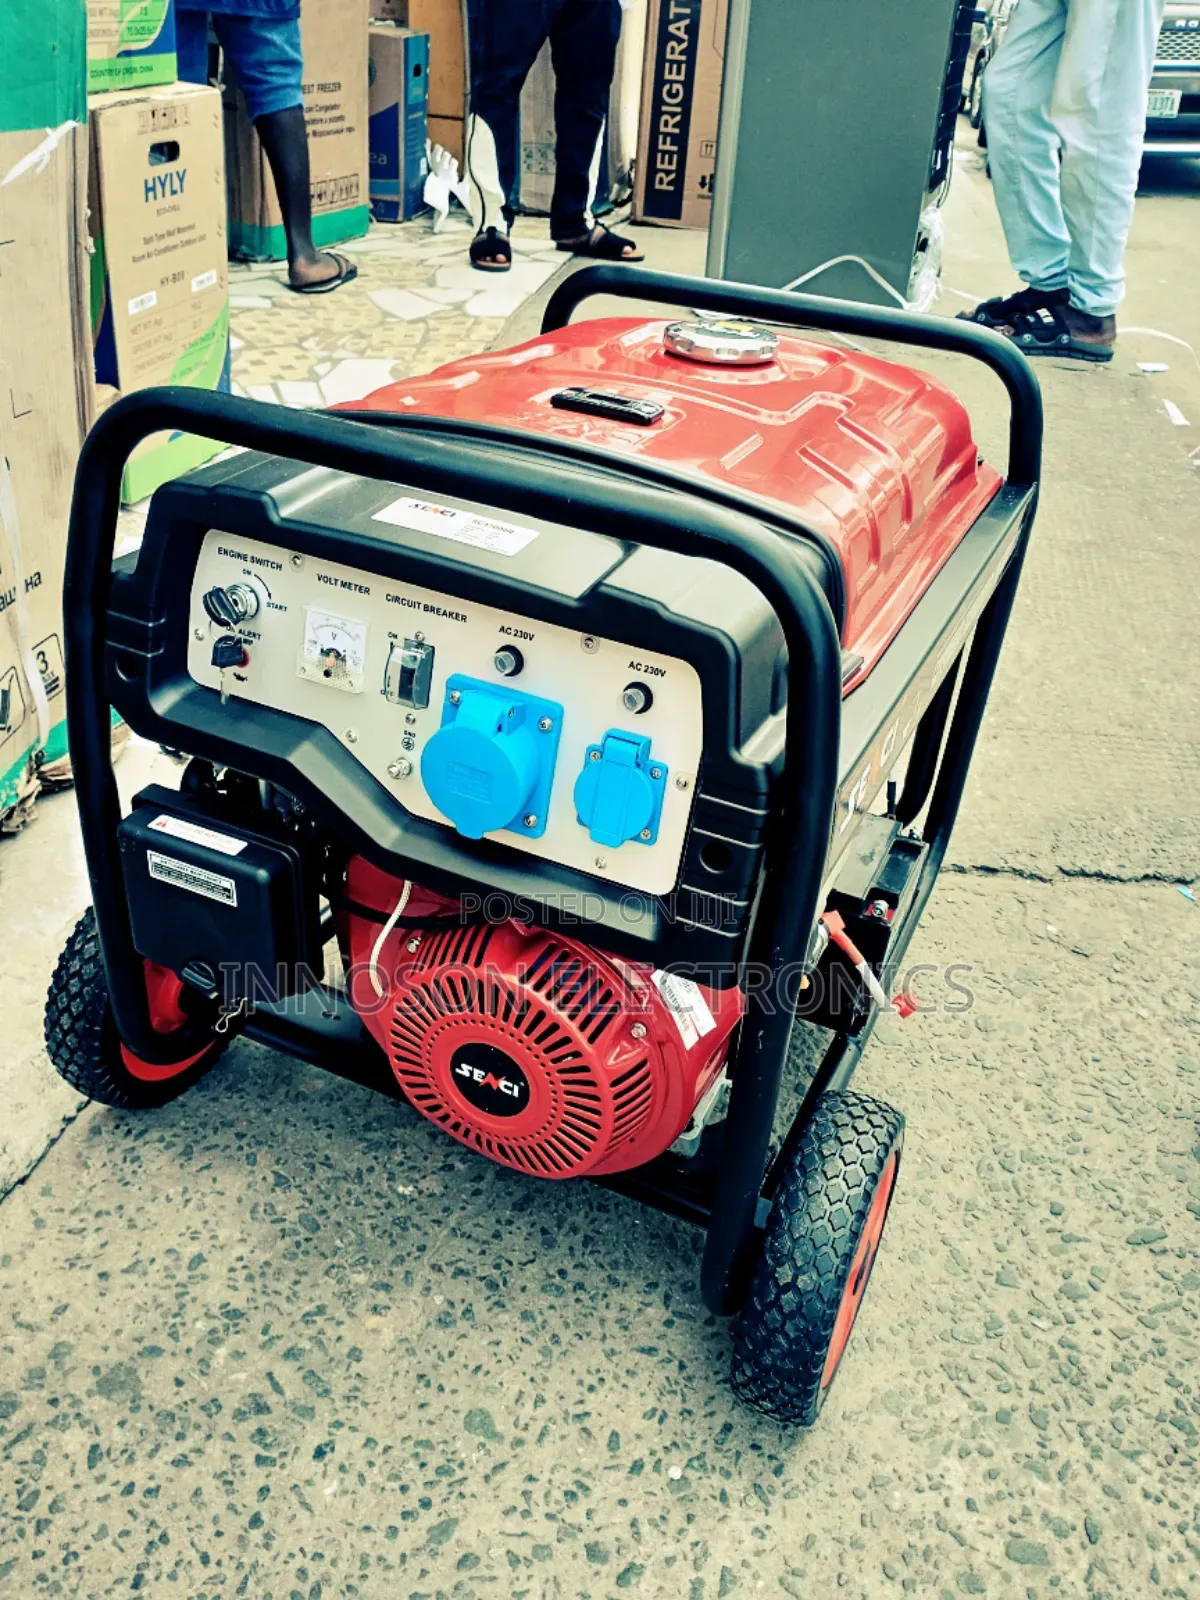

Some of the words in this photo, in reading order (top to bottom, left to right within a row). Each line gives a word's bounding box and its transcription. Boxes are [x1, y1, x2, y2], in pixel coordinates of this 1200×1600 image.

[302, 84, 315, 94] EST
[317, 82, 342, 93] FREEZER
[654, 0, 692, 191] REFRIGERAT
[144, 168, 187, 203] HYLY
[217, 546, 248, 562] ENGINE
[249, 555, 283, 571] SWITCH
[316, 573, 339, 587] VOLT
[340, 580, 371, 596] METER
[266, 601, 288, 613] START
[385, 592, 422, 610] CIRCUIT
[423, 603, 468, 623] BREAKER
[238, 628, 262, 641] ALERT
[331, 631, 337, 641] V
[498, 625, 513, 636] AC
[513, 628, 535, 642] 230V
[36, 650, 49, 675] 3
[628, 660, 642, 672] AC
[643, 662, 667, 678] 230V
[454, 1062, 520, 1098] SENCI
